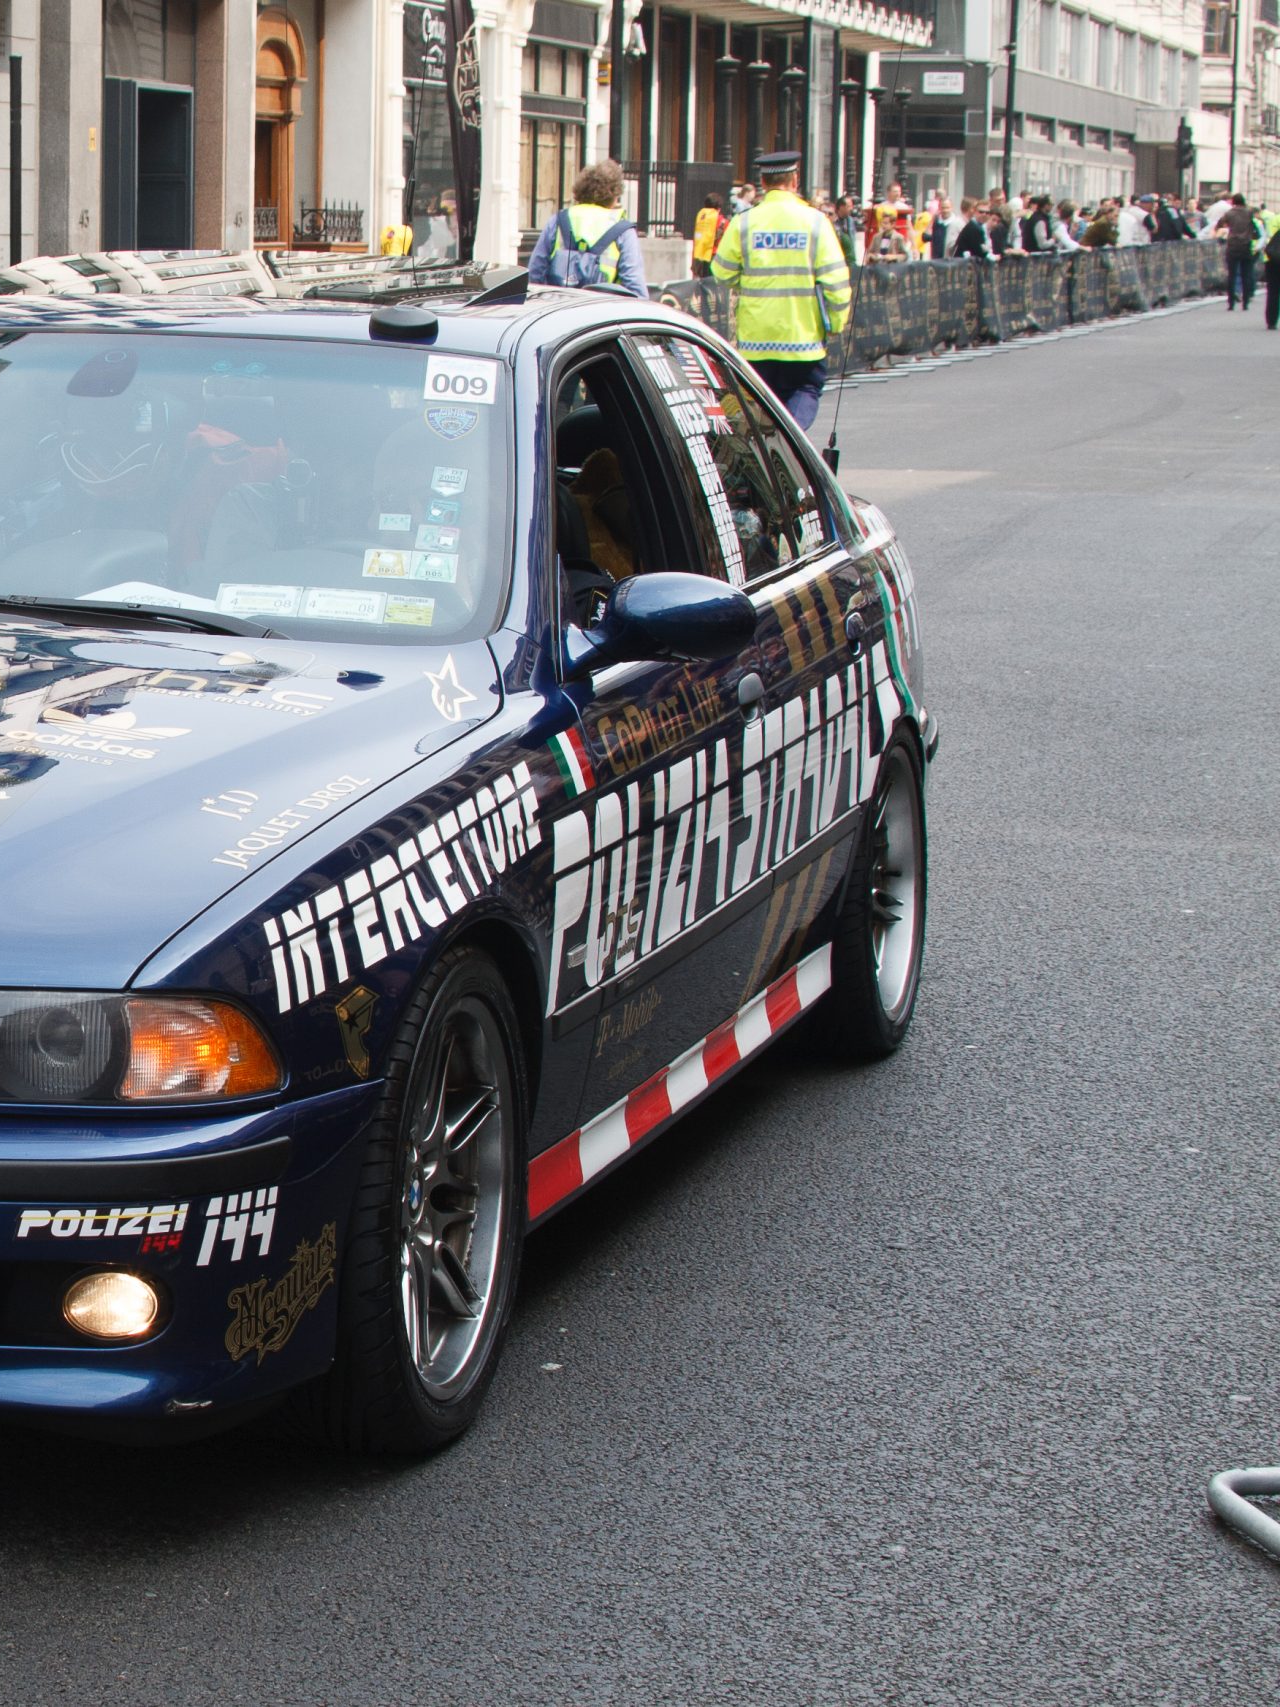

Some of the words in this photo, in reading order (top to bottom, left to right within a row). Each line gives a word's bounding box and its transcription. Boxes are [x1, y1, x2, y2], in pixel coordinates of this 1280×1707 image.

[753, 232, 808, 249] POLICE
[431, 373, 488, 396] 009
[213, 695, 320, 717] mobility
[5, 729, 160, 761] adidas
[14, 745, 115, 767] ORIGINALS
[211, 807, 312, 871] JAQUET
[297, 773, 372, 815] DROZ
[262, 760, 543, 1014] INTERCETTORE
[544, 737, 730, 1019] POLIZIA
[16, 1203, 191, 1238] POLIZEI
[195, 1185, 280, 1267] 144
